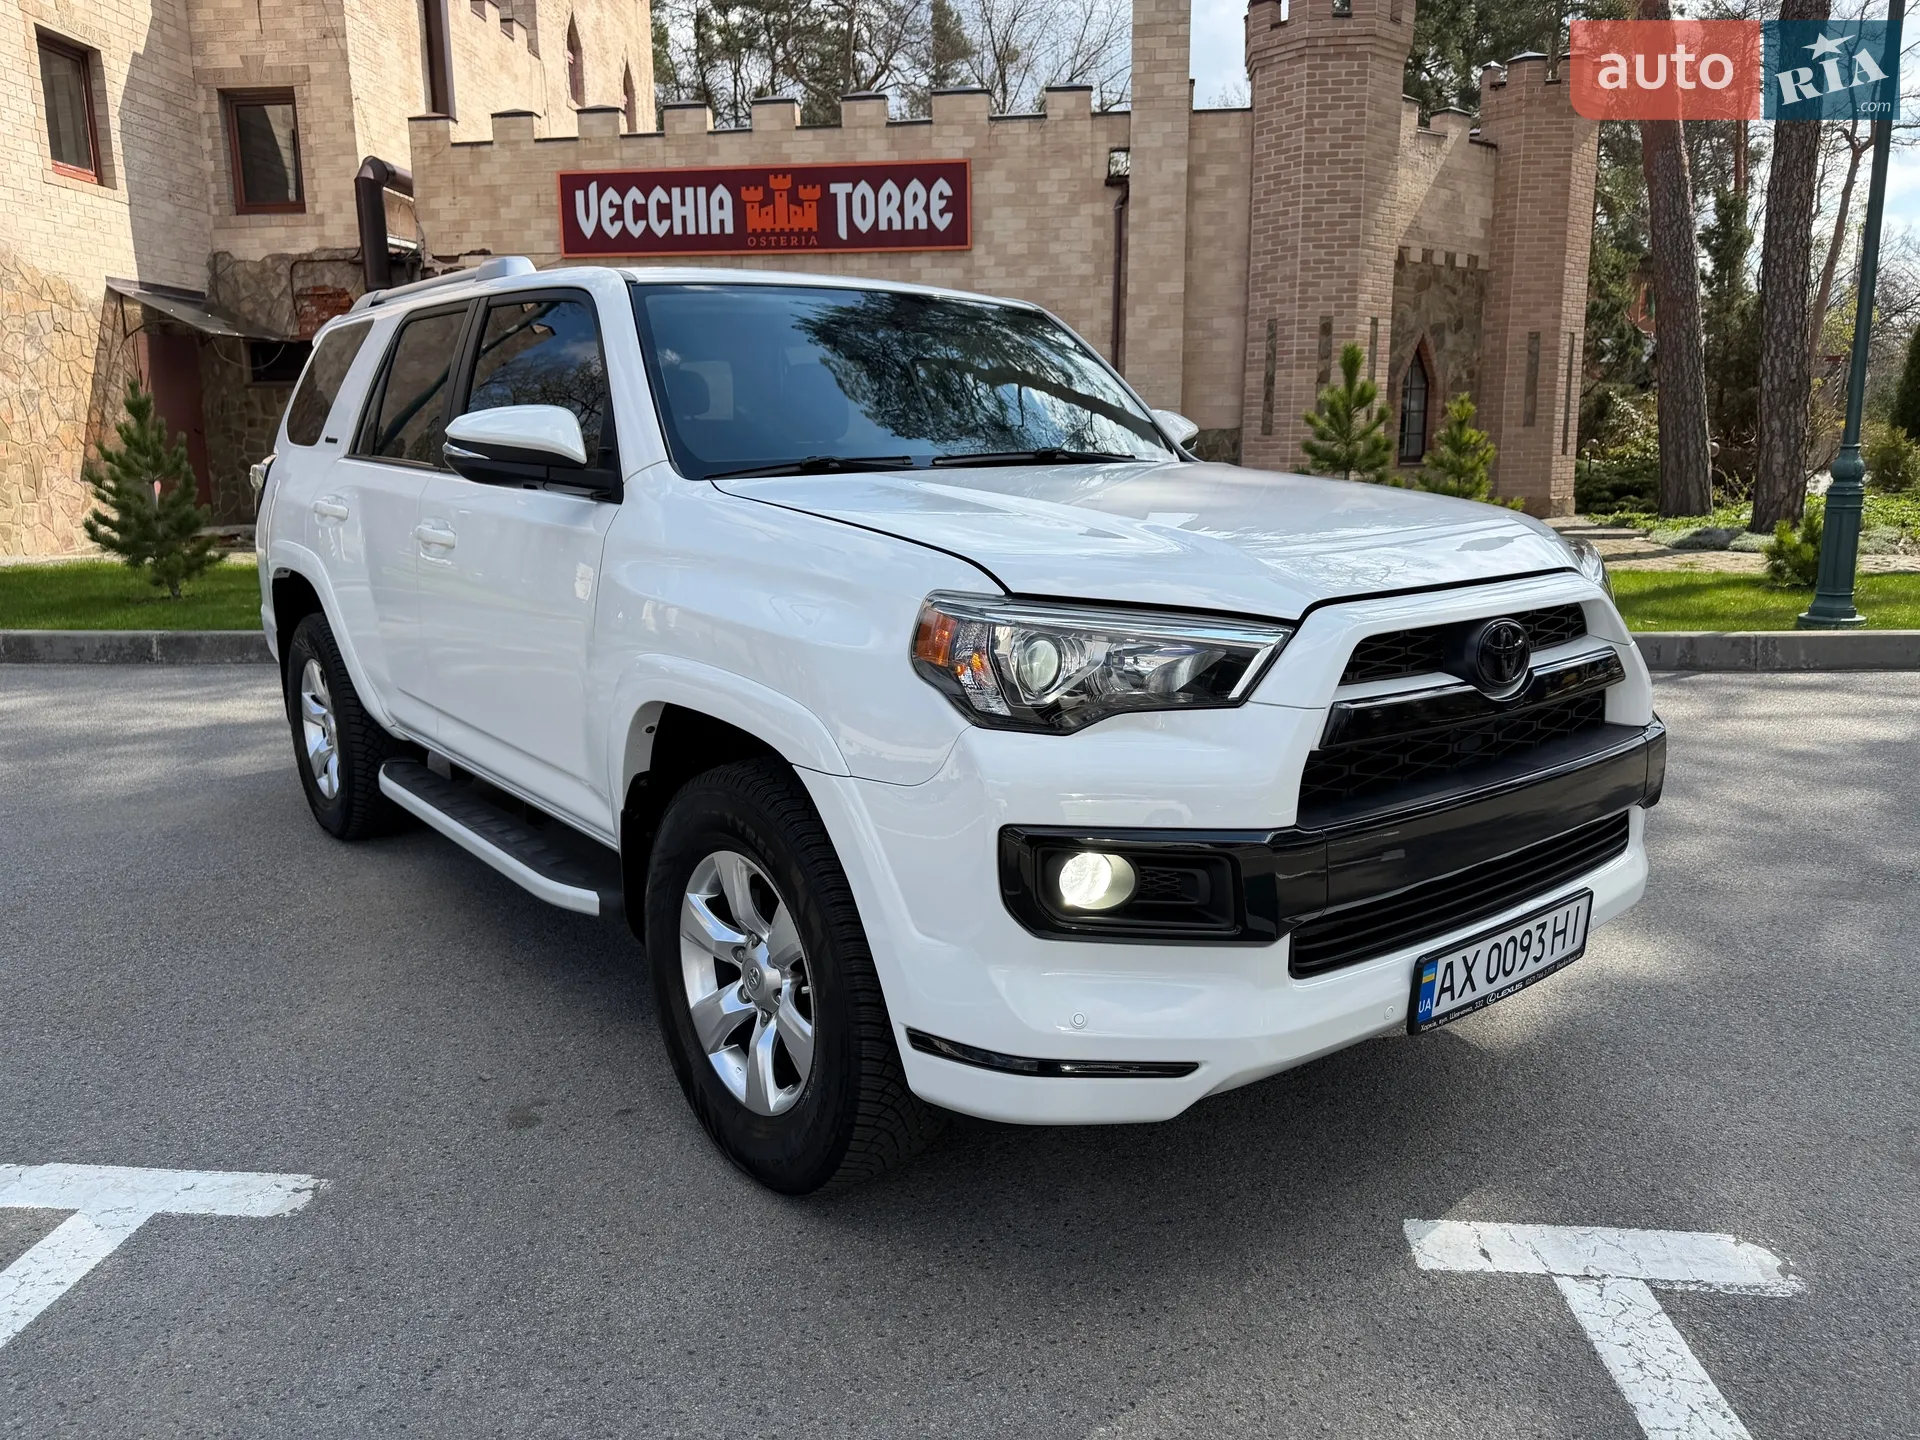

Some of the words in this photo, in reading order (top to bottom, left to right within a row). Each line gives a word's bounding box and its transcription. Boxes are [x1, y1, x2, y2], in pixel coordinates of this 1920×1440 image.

[575, 180, 734, 240] VECCHIA
[829, 177, 954, 241] TORRE
[747, 235, 819, 247] OSTERIA
[1496, 981, 1524, 999] LEXUS
[1418, 999, 1432, 1014] UA
